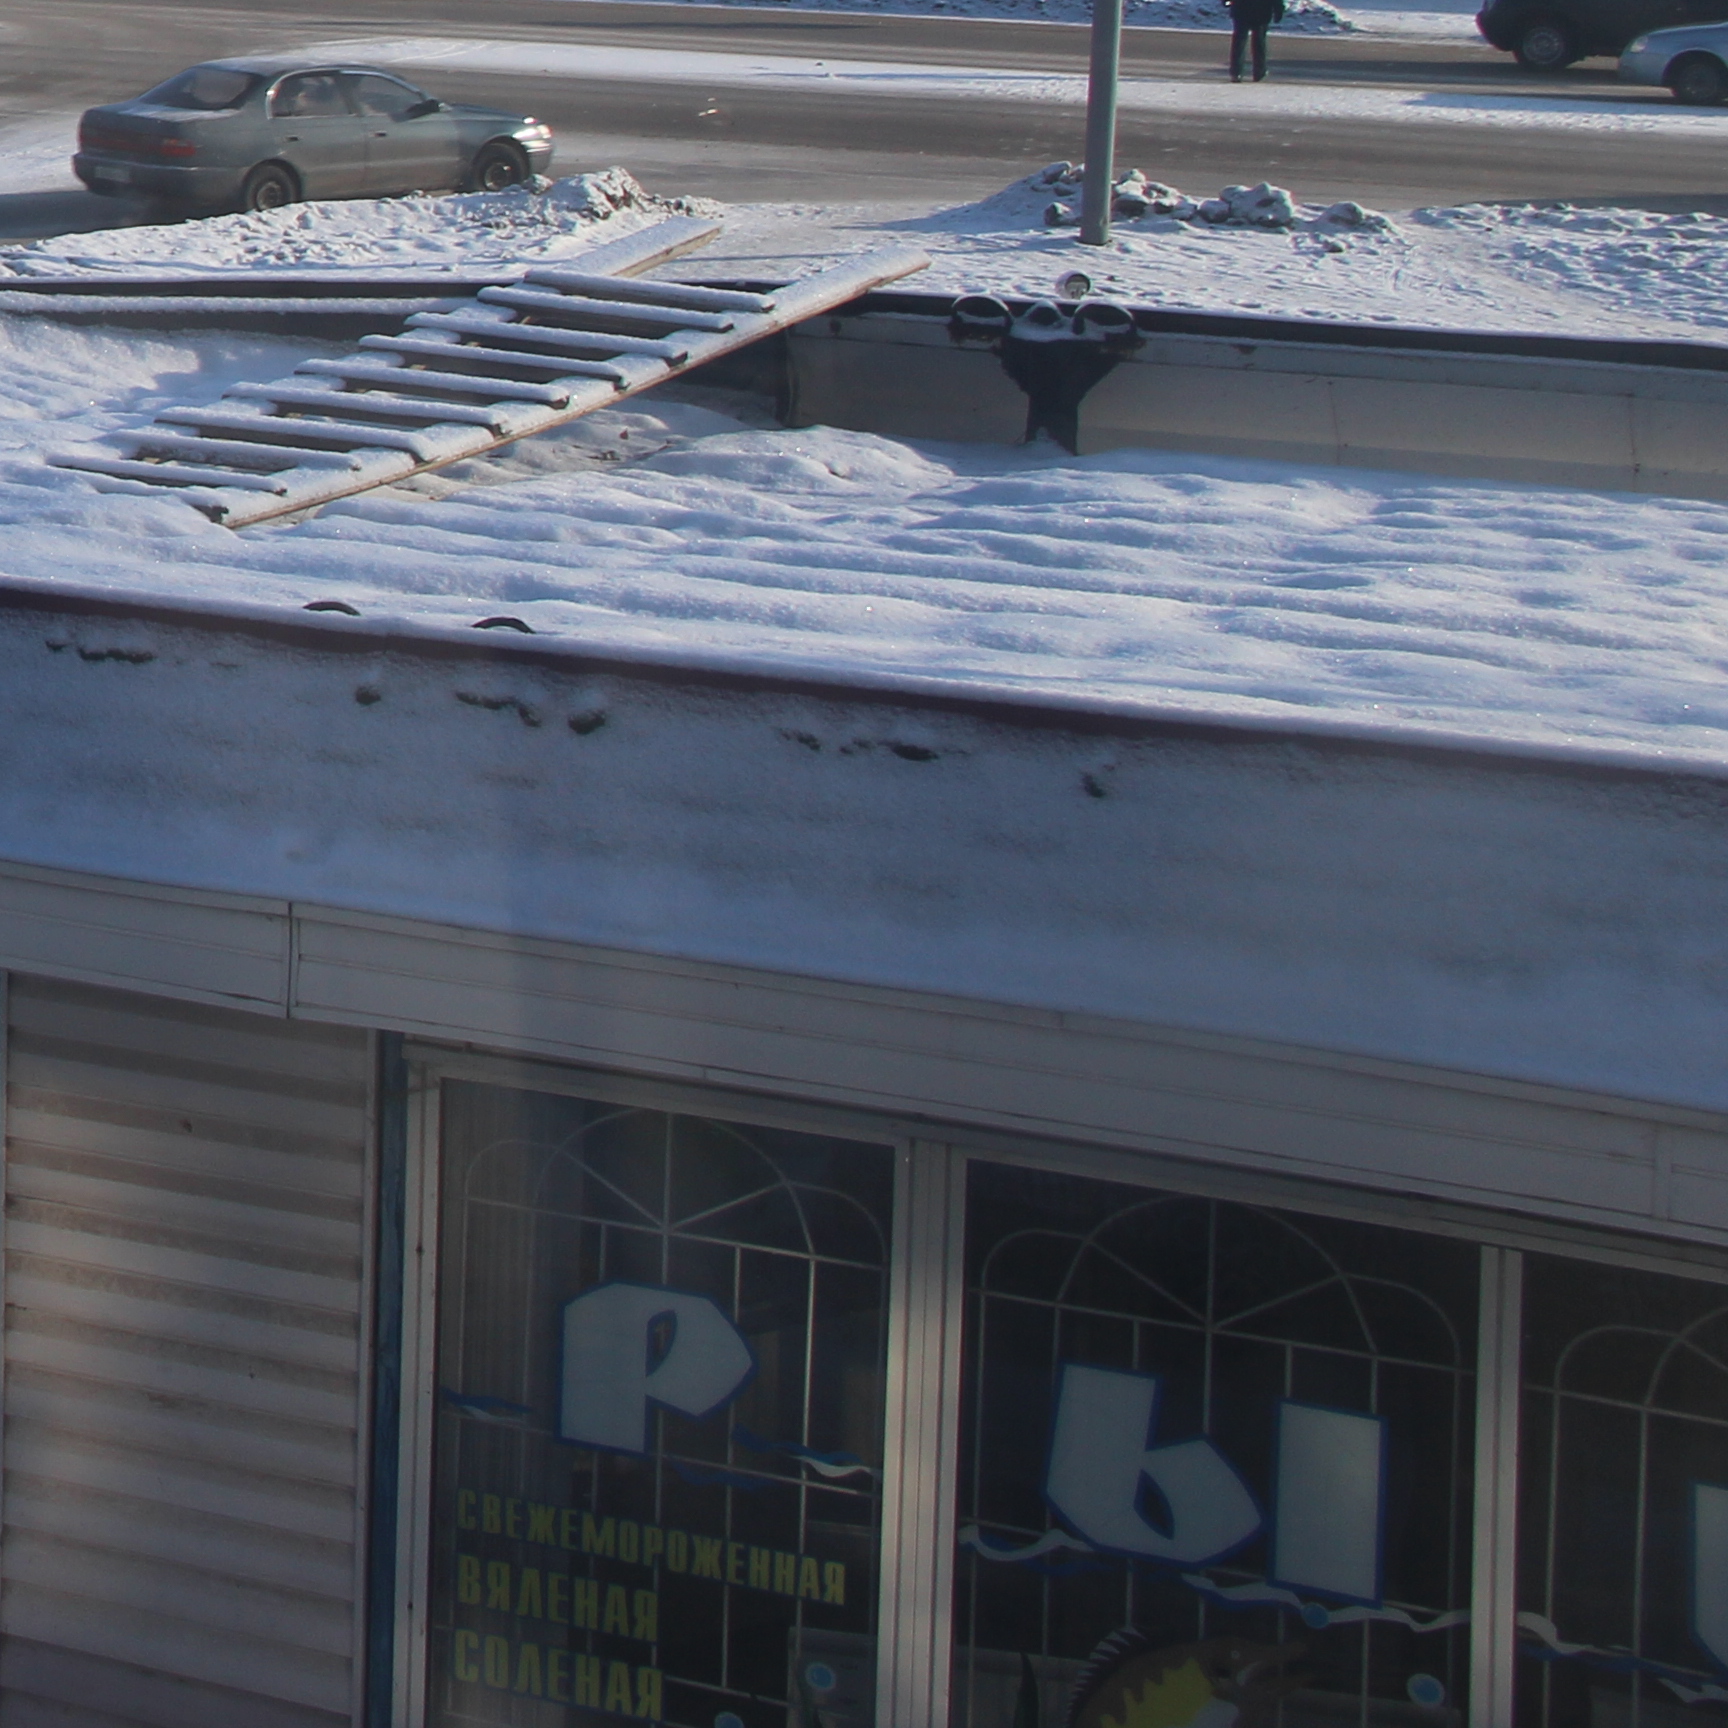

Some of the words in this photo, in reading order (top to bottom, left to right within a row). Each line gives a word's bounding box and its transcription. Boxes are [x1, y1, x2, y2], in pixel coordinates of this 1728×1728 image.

[456, 1487, 846, 1607] СВЕЖЕМОРОЖЕННАЯ
[457, 1553, 660, 1643] ВЯЛЕНАЯ
[453, 1629, 664, 1722] СОЛЕНАЯ
